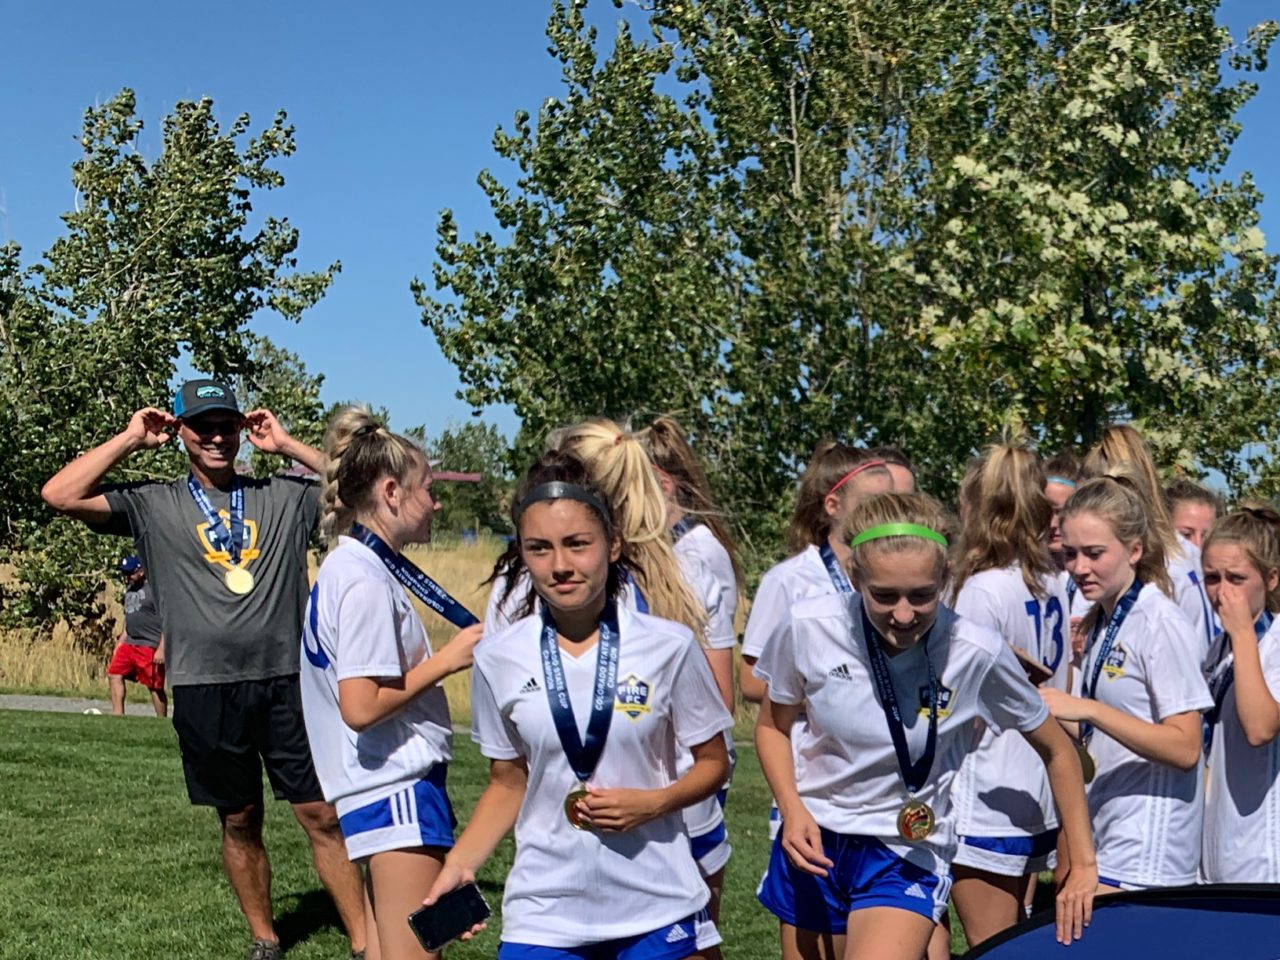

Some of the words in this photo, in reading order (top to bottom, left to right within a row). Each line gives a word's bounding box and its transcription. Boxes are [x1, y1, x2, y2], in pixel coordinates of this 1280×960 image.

[600, 639, 610, 666] STATE
[553, 665, 563, 692] STATE
[595, 665, 609, 711] COLORADO
[557, 692, 569, 710] CUP
[618, 686, 647, 697] FIRE
[626, 695, 641, 704] FC
